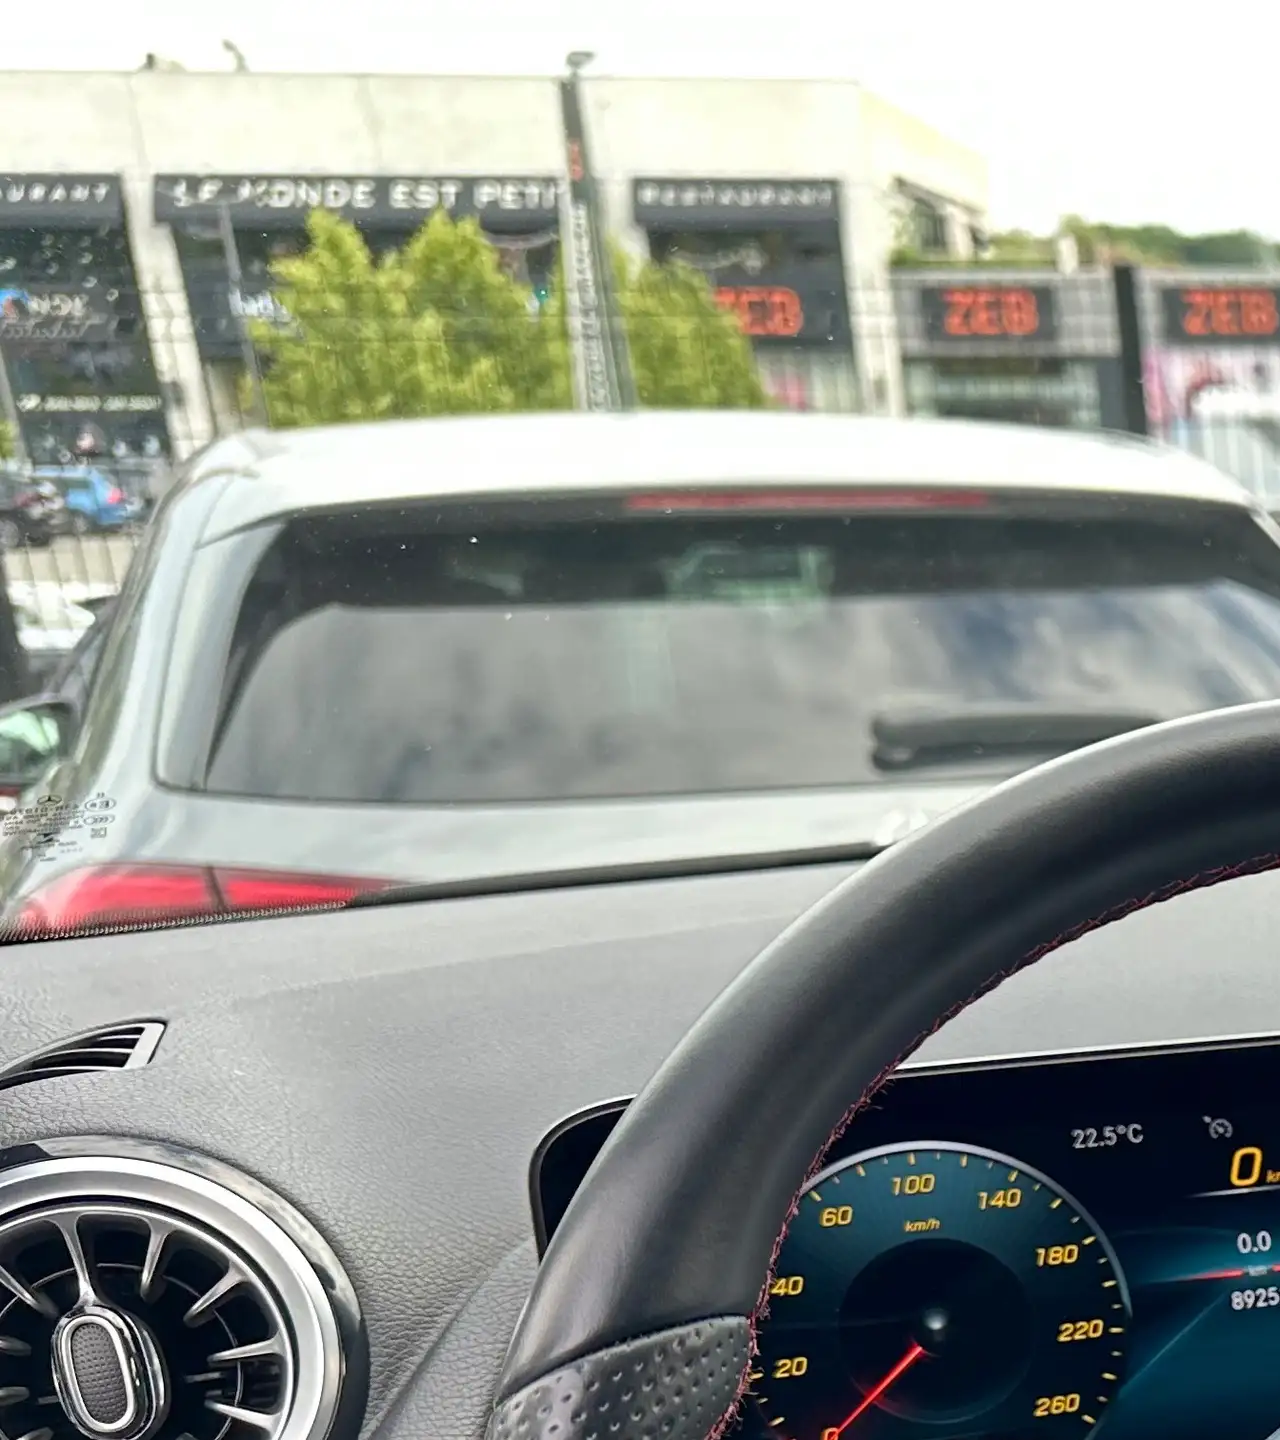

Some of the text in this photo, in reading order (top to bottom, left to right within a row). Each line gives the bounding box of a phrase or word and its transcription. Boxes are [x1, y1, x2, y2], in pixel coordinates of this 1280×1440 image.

[389, 179, 463, 209] EST
[943, 286, 1040, 336] ZEB
[1183, 286, 1280, 336] ZEB
[1070, 1123, 1144, 1149] 22.5°C
[1229, 1146, 1263, 1187] 0
[891, 1173, 936, 1195] 100
[978, 1189, 1022, 1210] 140
[820, 1205, 854, 1226] 60
[904, 1217, 941, 1233] km/h
[1236, 1230, 1272, 1254] 0.0
[1035, 1244, 1079, 1267] 180
[771, 1276, 804, 1296] 40
[1056, 1319, 1104, 1342] 220
[773, 1357, 808, 1378] 20
[1033, 1393, 1081, 1418] 260
